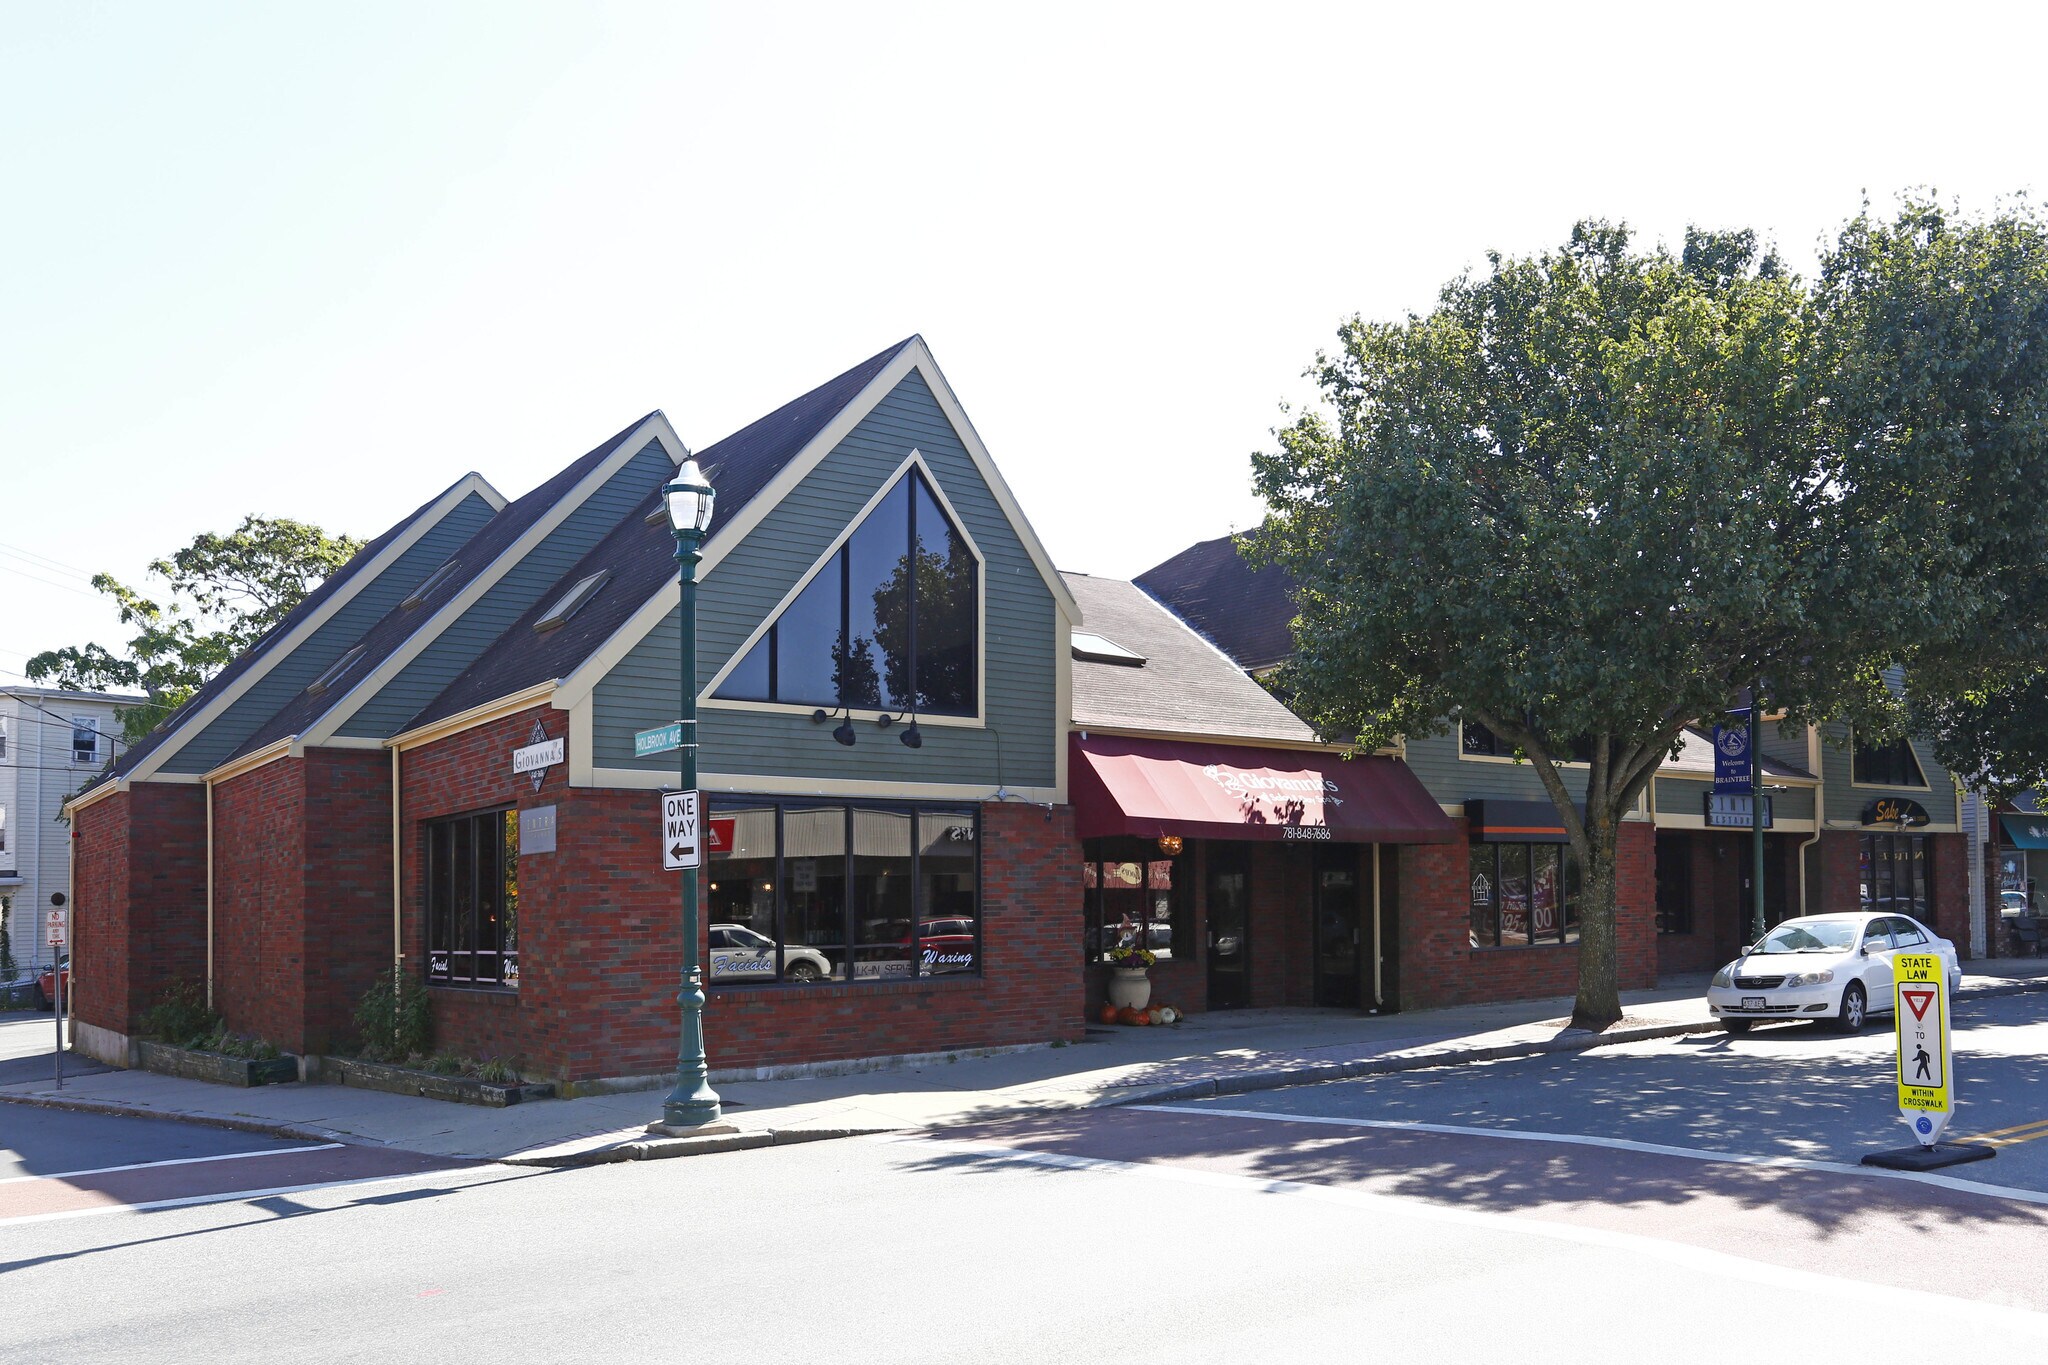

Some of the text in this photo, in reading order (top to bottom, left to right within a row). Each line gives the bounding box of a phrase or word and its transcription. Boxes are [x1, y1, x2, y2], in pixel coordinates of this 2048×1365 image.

[637, 729, 681, 751] HOLBROOK AVE
[1239, 772, 1339, 792] Giovanna's
[1715, 775, 1750, 784] BRAINTREE
[668, 798, 694, 817] ONE
[1709, 797, 1768, 813] SINTA
[1876, 801, 1899, 822] Sake
[668, 819, 695, 838] WAY
[1283, 827, 1331, 839] 781-848-7686
[714, 955, 772, 976] Facials
[923, 949, 973, 967] Waxing
[1901, 958, 1932, 968] STATE
[1907, 970, 1928, 980] LAW
[1915, 1032, 1925, 1040] TO
[1911, 1089, 1934, 1097] WITHIN
[1903, 1098, 1943, 1108] CROSSWALK
